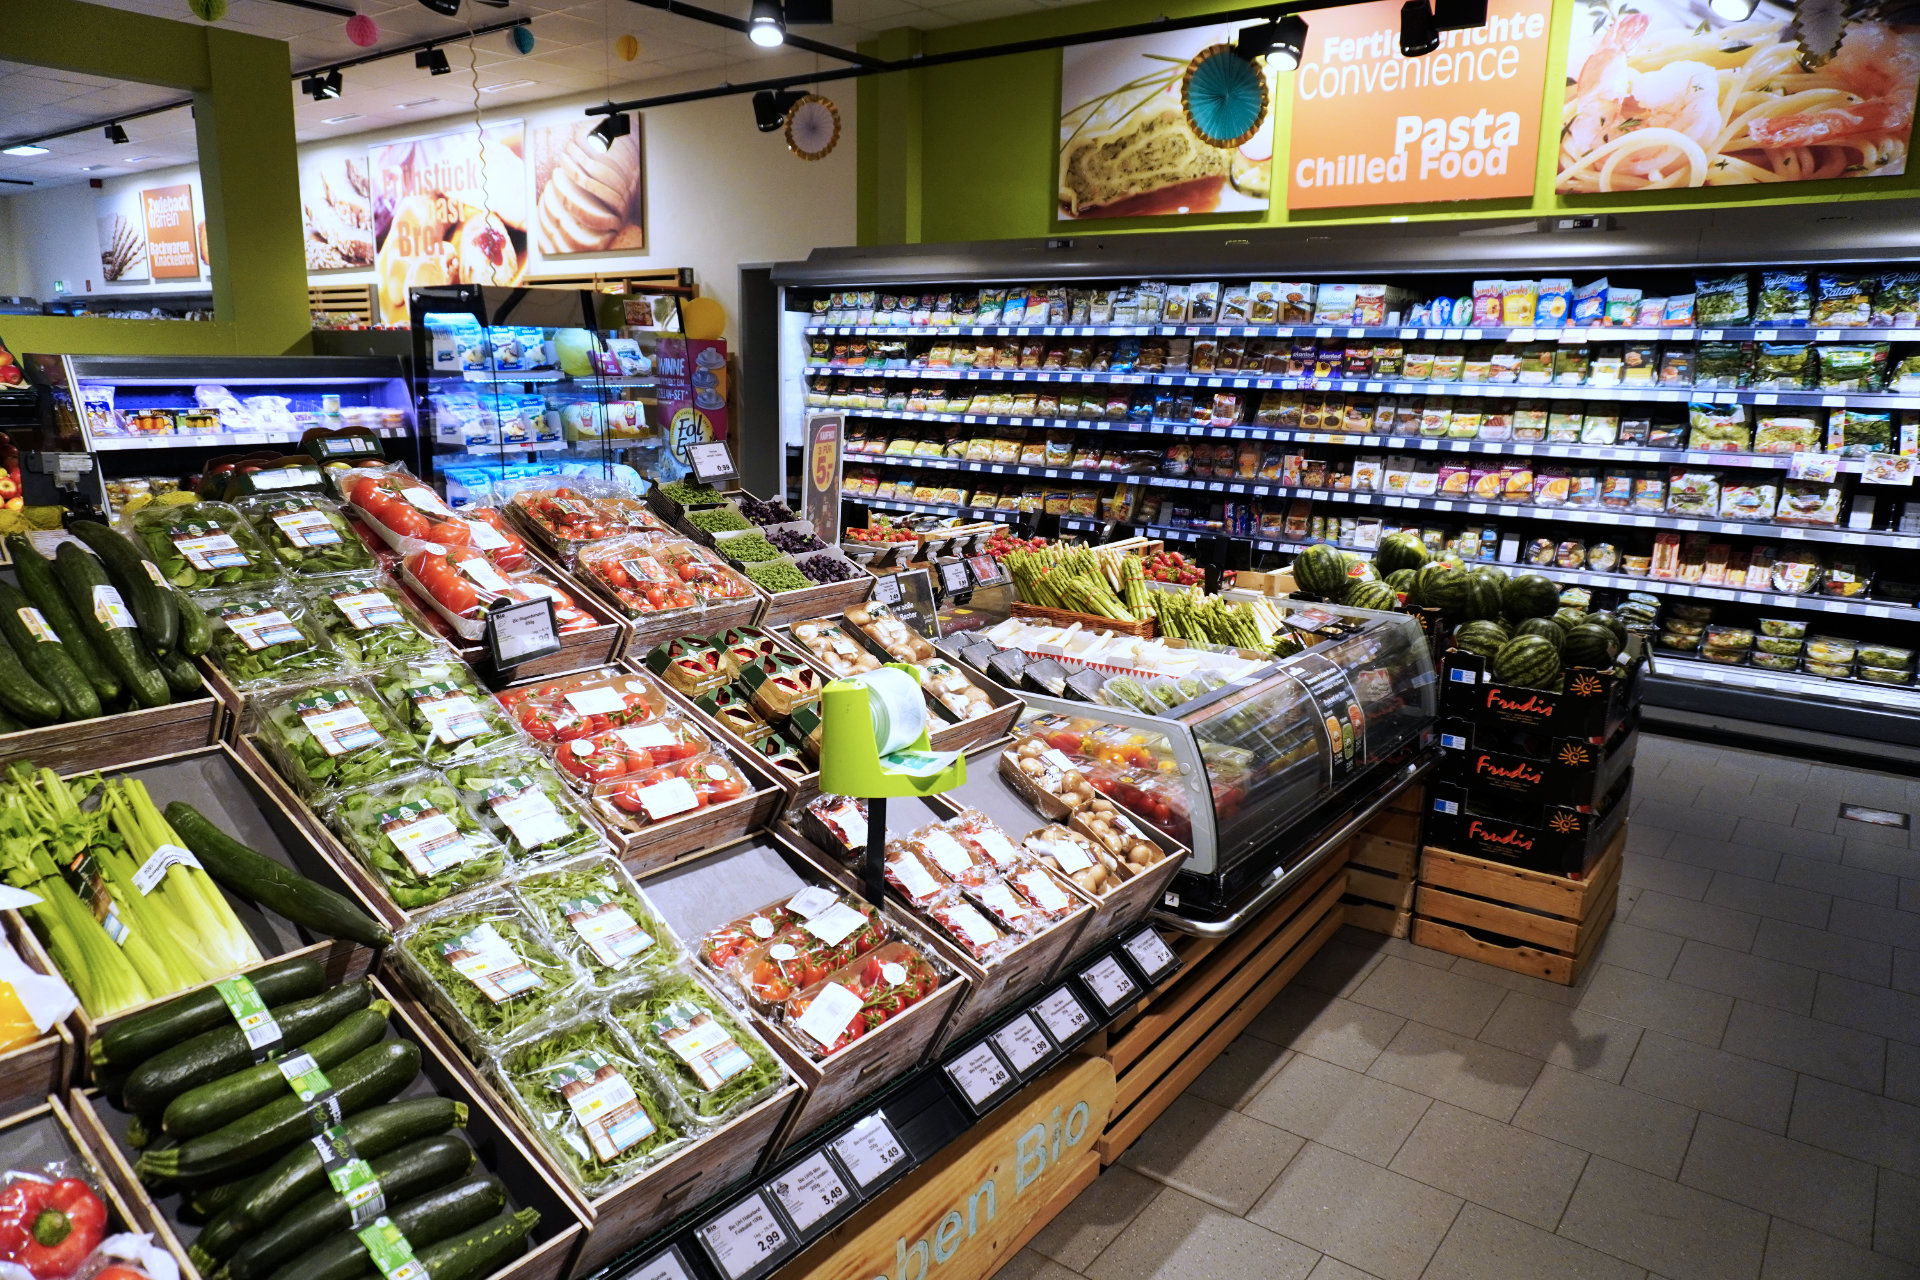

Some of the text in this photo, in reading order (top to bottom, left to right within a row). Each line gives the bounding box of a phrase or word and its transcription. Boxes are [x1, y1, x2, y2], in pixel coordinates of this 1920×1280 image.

[1299, 44, 1520, 101] Convenience
[1395, 108, 1521, 156] Pasta
[1296, 144, 1509, 189] Chilled Food
[150, 240, 190, 256] Backwaren
[1487, 688, 1553, 717] Frudis
[1476, 755, 1542, 784] Frudis
[1469, 820, 1533, 850] Frudis
[880, 1146, 899, 1164] 3,49
[821, 1186, 843, 1205] 3,49
[871, 1100, 1090, 1280] ben Bio
[705, 1224, 717, 1233] Bio
[757, 1230, 780, 1252] 2,99
